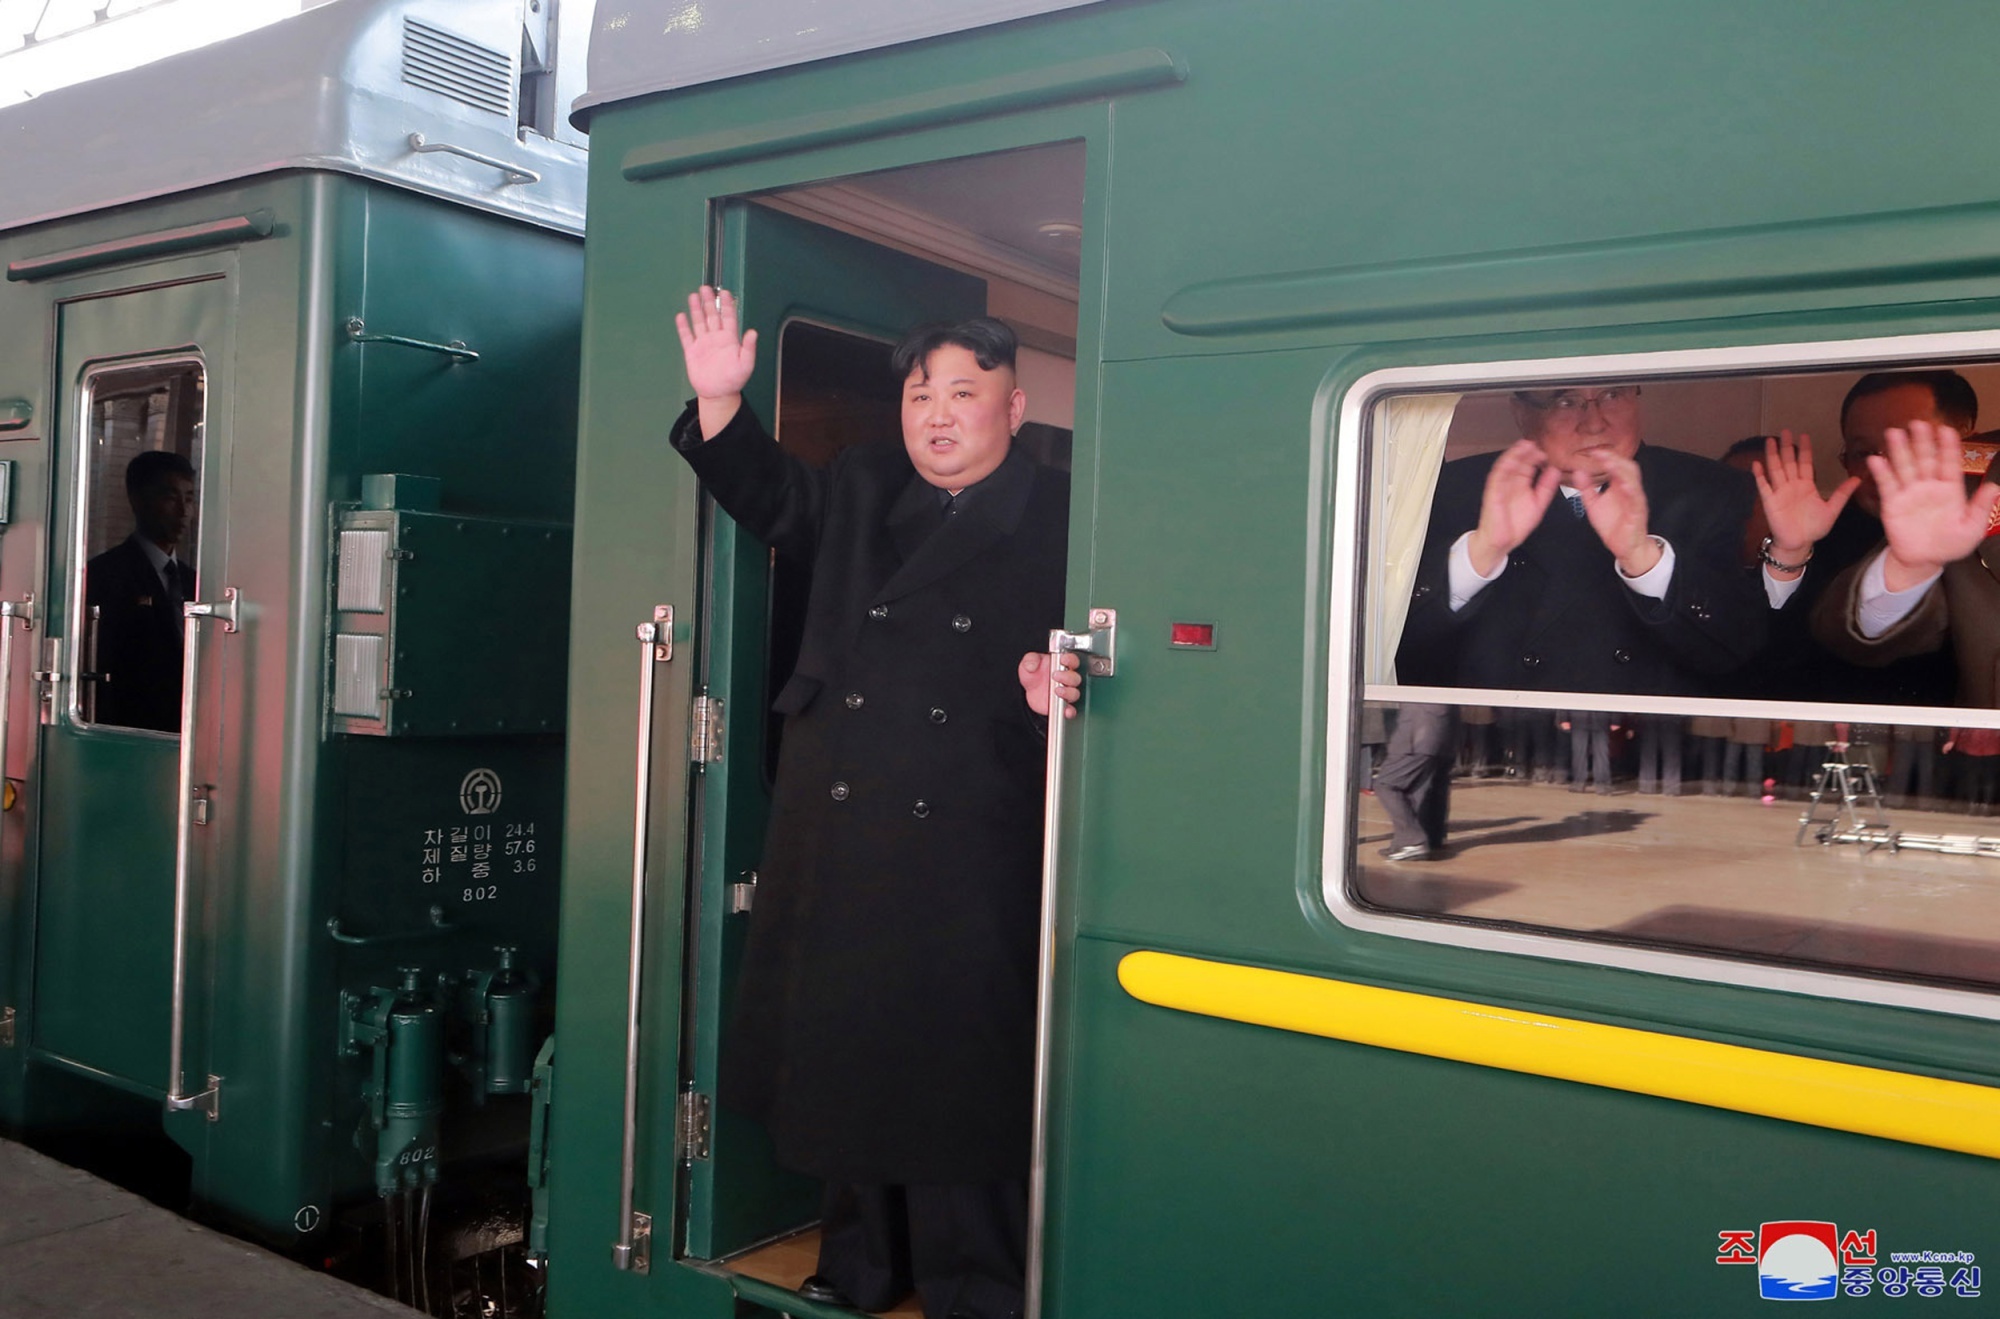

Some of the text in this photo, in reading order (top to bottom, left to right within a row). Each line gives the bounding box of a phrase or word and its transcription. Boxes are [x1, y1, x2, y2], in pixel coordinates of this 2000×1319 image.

[505, 822, 535, 838] 24.4
[504, 839, 536, 856] 57.6
[513, 858, 537, 873] 3.6
[462, 885, 498, 902] 802
[399, 1146, 435, 1165] 802
